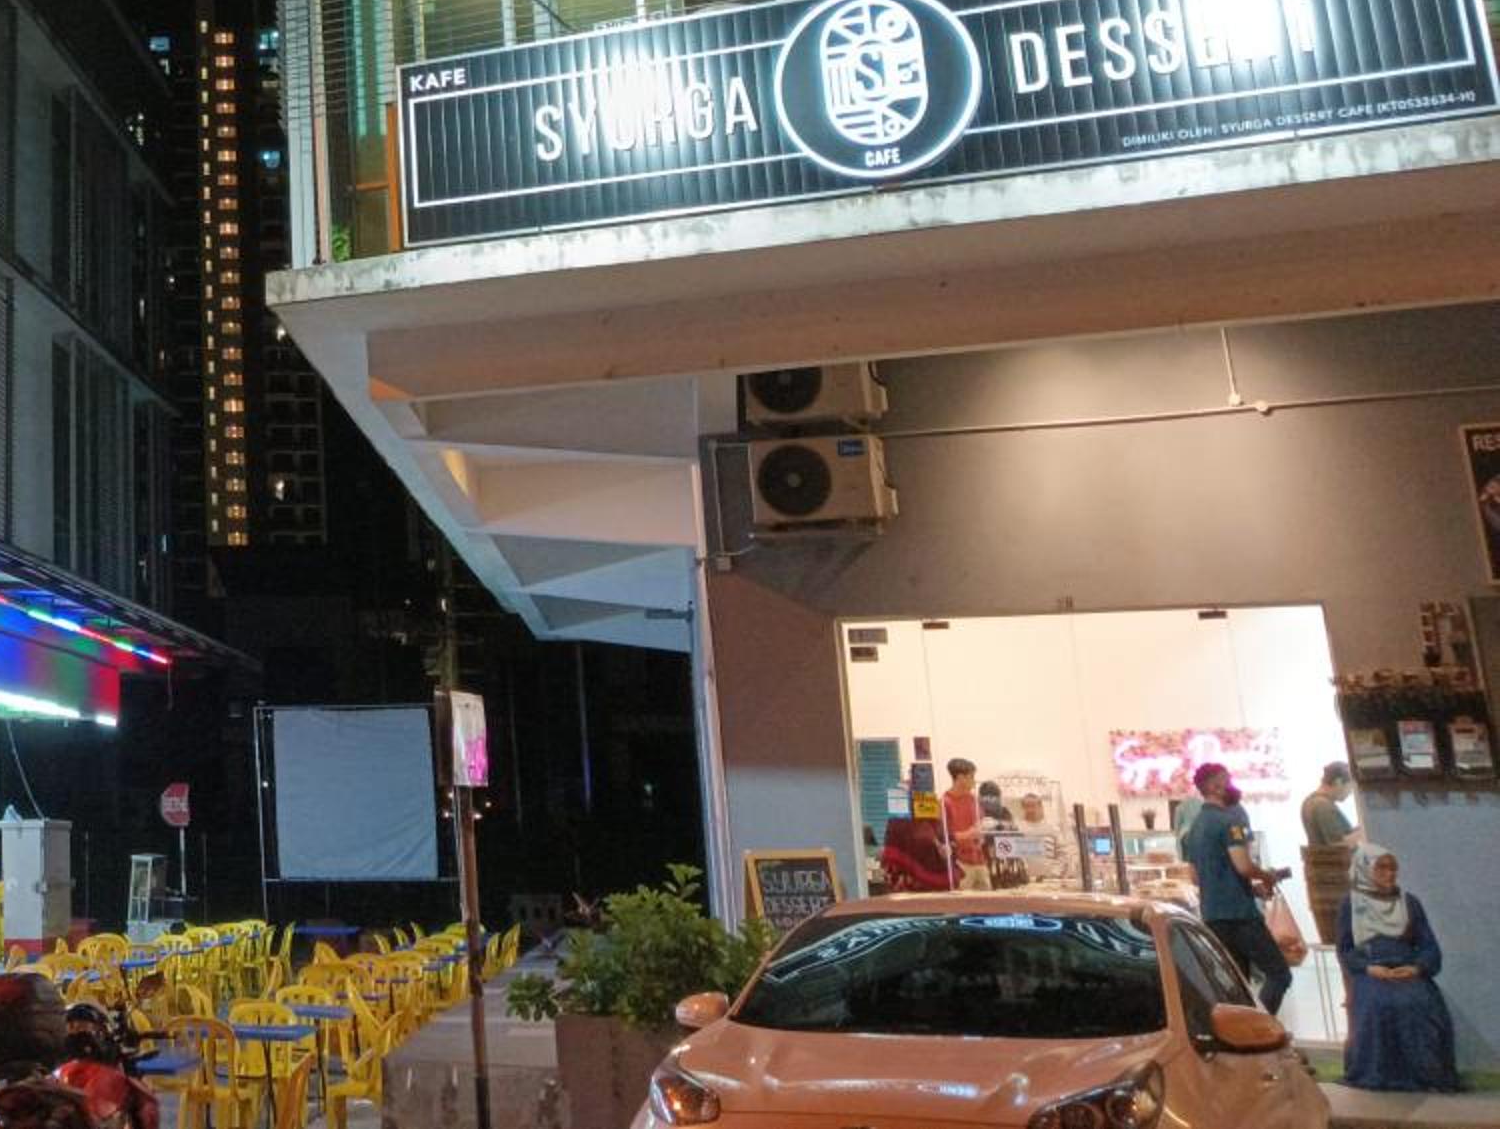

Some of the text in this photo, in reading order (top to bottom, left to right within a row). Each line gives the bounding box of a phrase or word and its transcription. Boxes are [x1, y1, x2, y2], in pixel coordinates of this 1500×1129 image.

[409, 68, 467, 93] KAFE
[1122, 130, 1175, 149] DIMILIKI
[1220, 117, 1273, 135] SYURGA
[1337, 103, 1375, 119] CAFE
[864, 147, 901, 167] CAFE
